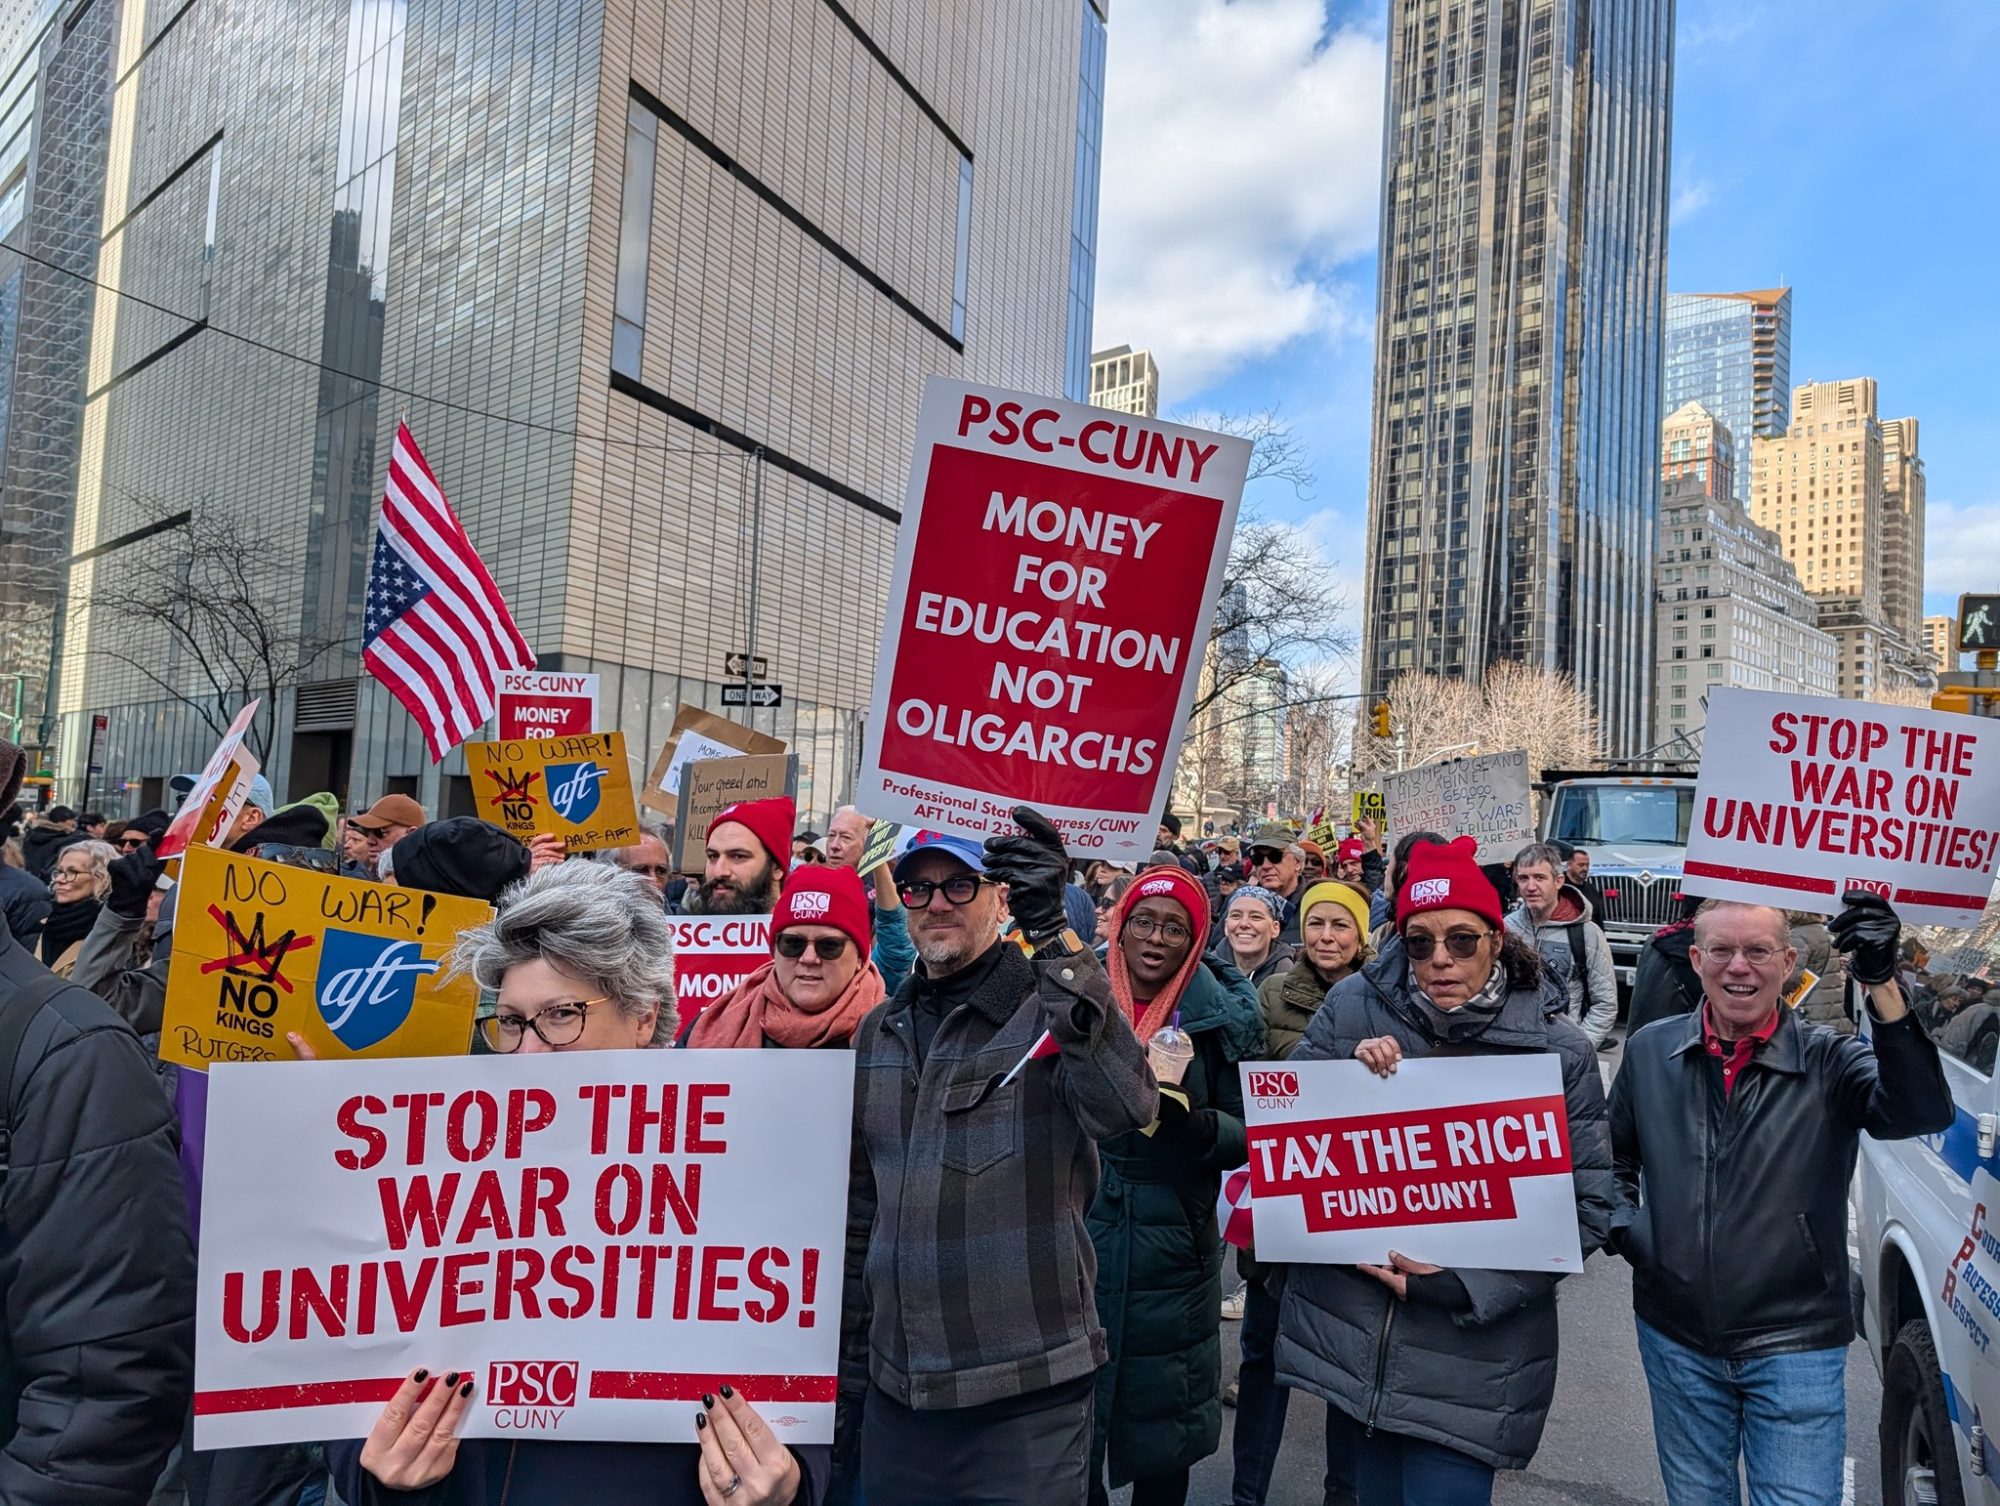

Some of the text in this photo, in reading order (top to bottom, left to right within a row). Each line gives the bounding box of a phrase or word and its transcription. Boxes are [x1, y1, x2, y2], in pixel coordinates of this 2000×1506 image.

[957, 394, 1219, 483] PSC-CUNY
[982, 490, 1162, 559] MONEY
[1013, 553, 1108, 609] FOR
[914, 591, 1181, 675] EDUCATION
[504, 674, 587, 694] PSC-CUNY
[729, 690, 773, 700] ONE WAY
[989, 661, 1093, 714] NOT
[514, 706, 572, 724] MONEY
[486, 733, 613, 764] NO WAR!
[896, 698, 1157, 775] OLIGARCHS
[1768, 711, 1978, 777] STOP THE
[1448, 757, 1489, 775] DOGE
[1491, 753, 1523, 769] AND
[692, 769, 715, 797] Your
[746, 767, 769, 790] and
[1397, 769, 1489, 800] HIS CABINET
[1789, 759, 1960, 821] WAR ON
[502, 803, 533, 821] NO
[881, 778, 979, 813] Professional
[980, 801, 1017, 820] Staf
[1359, 792, 1386, 807] IC
[1391, 793, 1440, 816] STARVED
[1460, 811, 1470, 825] 3
[1477, 802, 1525, 821] WARS
[506, 822, 536, 831] KINGS
[913, 804, 945, 822] AFT
[946, 811, 988, 832] Local
[1060, 832, 1105, 848] FL-CIO
[1393, 804, 1457, 828] MURDERED
[1467, 818, 1518, 836] BILLION
[1702, 796, 2000, 873] UNIVERSITIES!
[223, 863, 438, 936] NO WAR!
[792, 892, 830, 911] PSC
[1412, 879, 1450, 900] PSC
[1414, 895, 1446, 908] CUNY
[792, 909, 825, 920] CUNY
[218, 975, 279, 1019] NO
[215, 1010, 275, 1039] KINGS
[1250, 1072, 1299, 1097] PSC
[1257, 1097, 1296, 1110] CUNY
[334, 1083, 731, 1171] STOP THE
[1251, 1110, 1564, 1183] TAX THE RICH
[377, 1162, 702, 1251] WAR ON
[1321, 1179, 1493, 1219] FUND CUNY!
[221, 1244, 821, 1344] UNIVERSITIES!
[1941, 1267, 1990, 1354] RESPECT
[489, 1362, 579, 1406] PSC
[493, 1409, 566, 1430] CUNY
